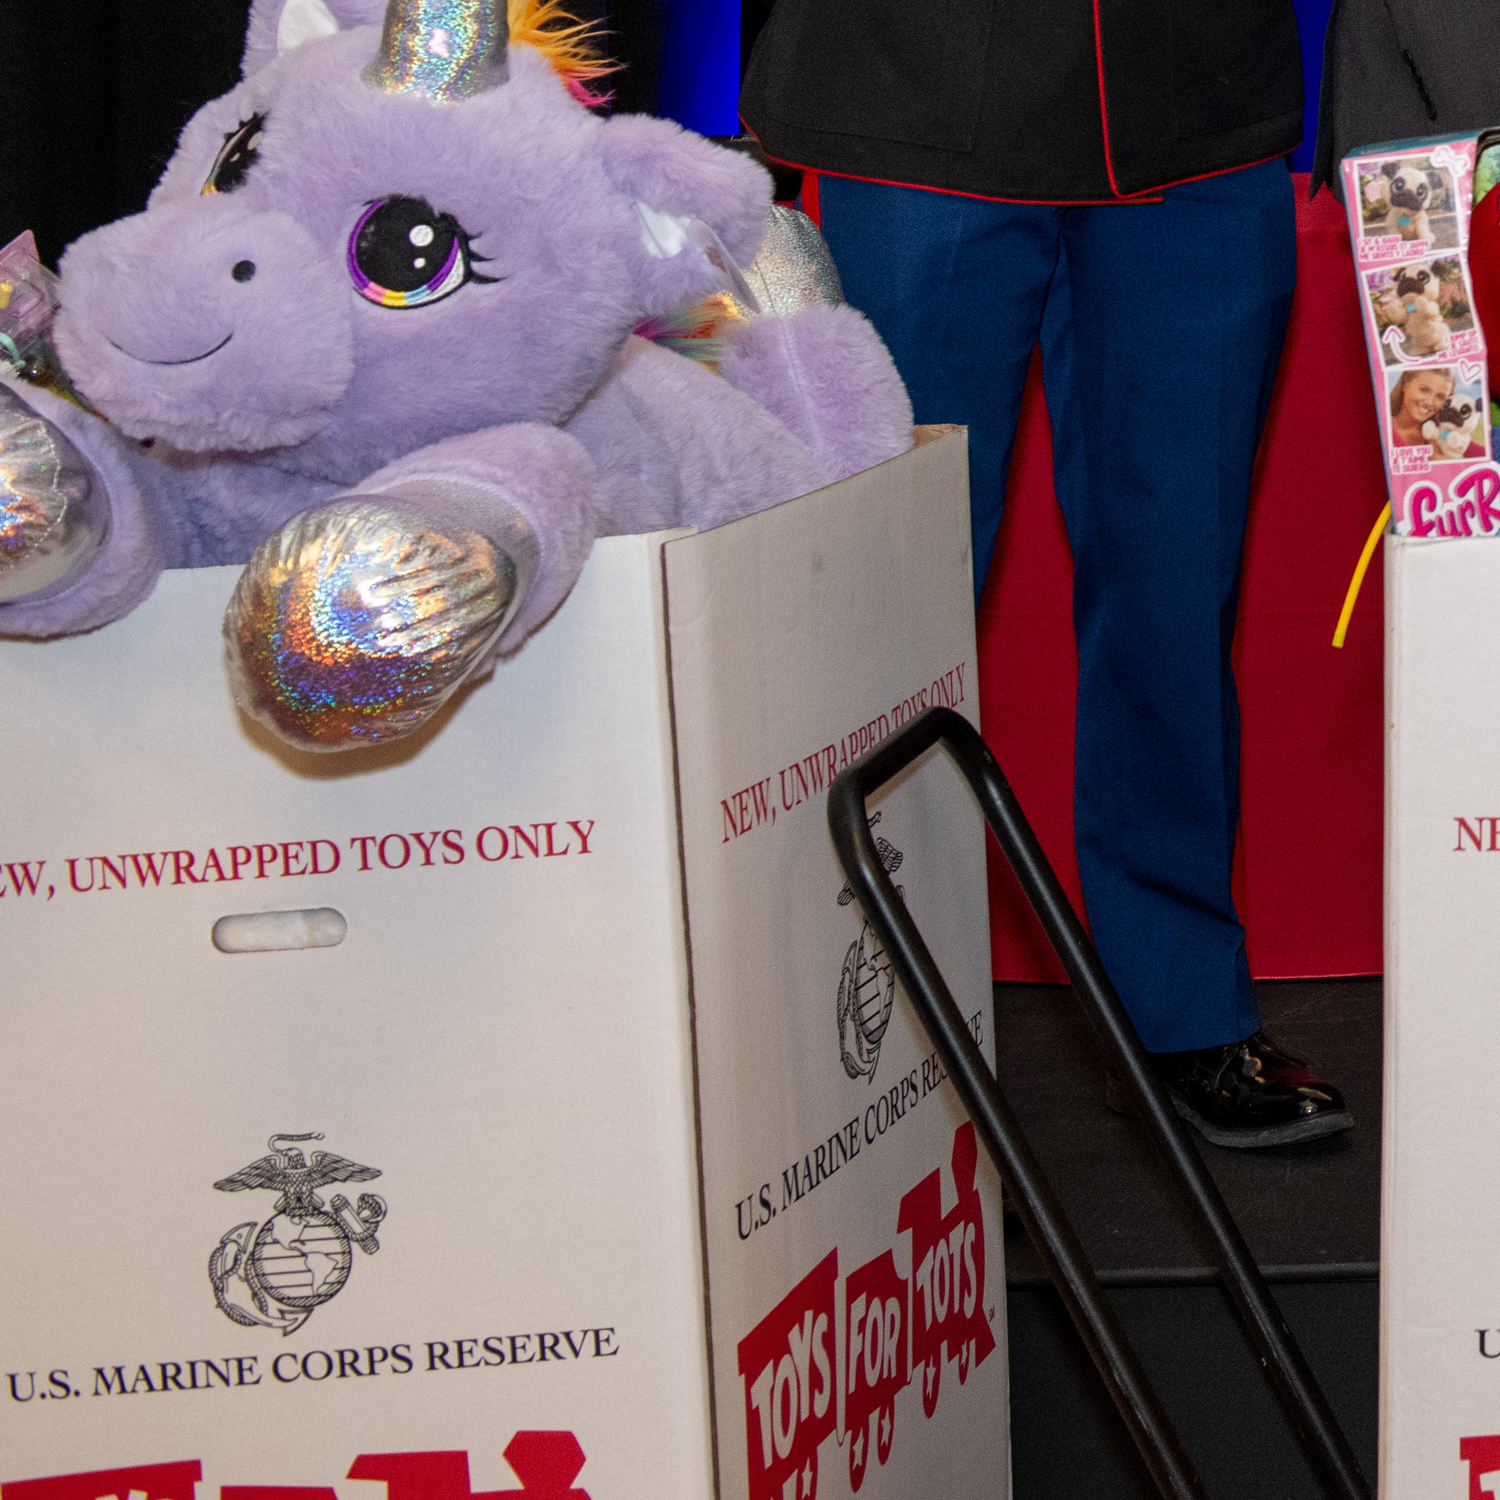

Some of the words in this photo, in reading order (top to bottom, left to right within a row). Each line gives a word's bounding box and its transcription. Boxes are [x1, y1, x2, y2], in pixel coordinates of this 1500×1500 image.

[720, 777, 777, 844] NEW,
[778, 714, 890, 812] UNWRAPPED
[930, 661, 966, 709] ONLY
[0, 859, 55, 900] W,
[65, 839, 341, 893] UNWRAPPED
[350, 829, 466, 872] TOYS
[475, 819, 595, 862] ONLY
[734, 1182, 777, 1240] U.S.
[781, 1116, 861, 1212] MARINE
[864, 1069, 919, 1145] CORPS
[6, 1369, 81, 1402] U.S.
[92, 1355, 262, 1397] MARINE
[271, 1342, 414, 1384] CORPS
[424, 1327, 620, 1372] RESERVE
[750, 1310, 831, 1470] TOYS
[849, 1291, 901, 1395] FOR
[916, 1219, 977, 1332] TOTS
